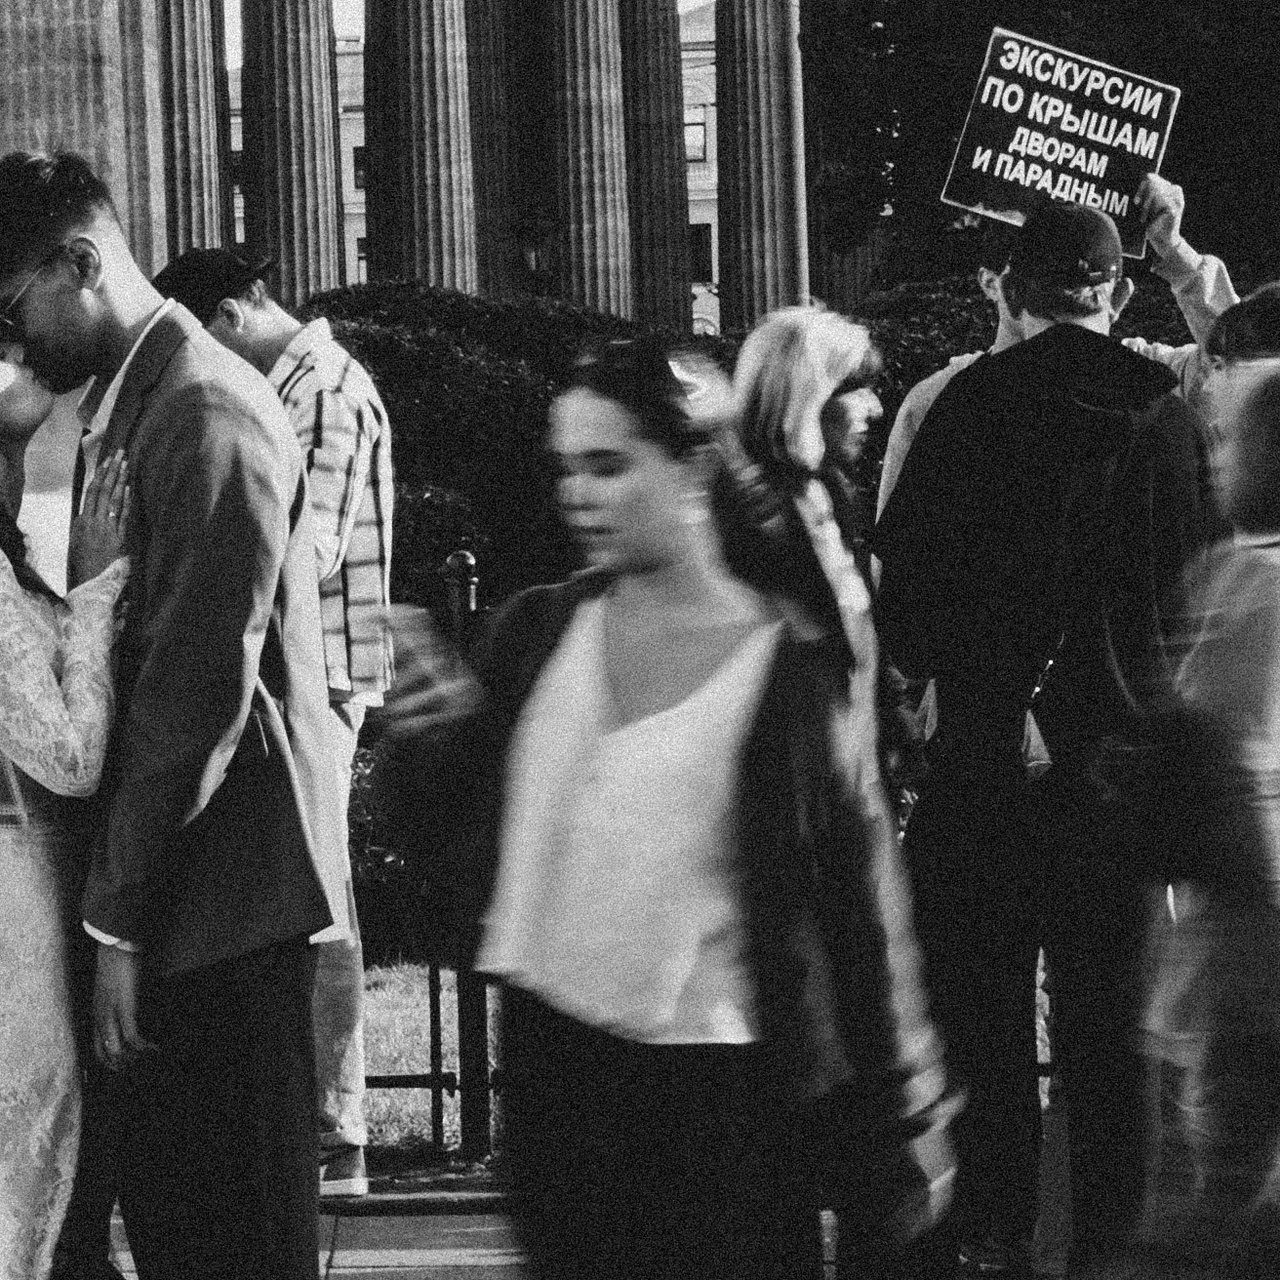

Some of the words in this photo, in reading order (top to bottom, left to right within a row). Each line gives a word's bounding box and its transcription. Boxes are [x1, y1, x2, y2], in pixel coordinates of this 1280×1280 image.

[999, 40, 1163, 119] ЭКСКУРСИИ
[980, 75, 1025, 114] ПО
[1027, 92, 1160, 160] КРЫШАМ
[1008, 126, 1109, 178] ДВОРАМ
[971, 146, 992, 173] И
[993, 153, 1129, 217] ПАРАДНЫМ
